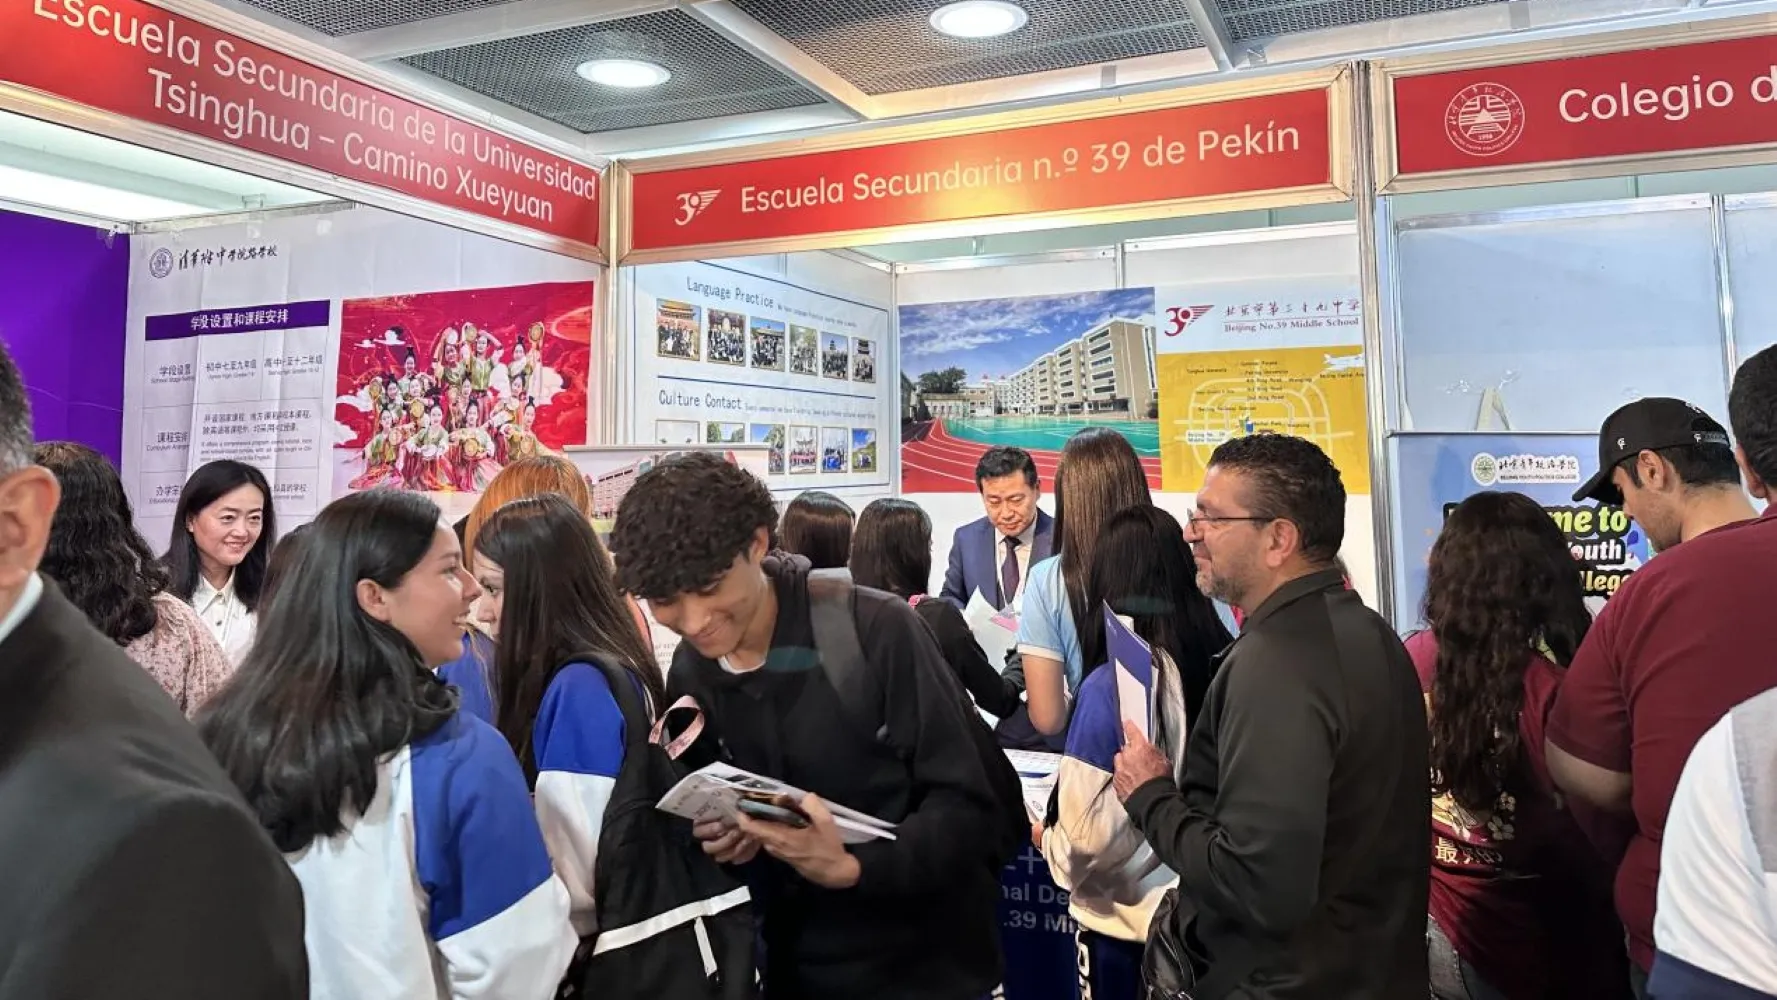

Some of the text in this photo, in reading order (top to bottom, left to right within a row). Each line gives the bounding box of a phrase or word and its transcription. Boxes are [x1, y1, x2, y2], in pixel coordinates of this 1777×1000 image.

[1558, 74, 1734, 122] Colegio
[213, 39, 395, 132] Secundaria
[404, 110, 436, 145] de
[444, 119, 466, 155] la
[473, 131, 597, 201] Universidad
[148, 68, 310, 150] Tsinghua
[343, 132, 447, 191] Camino
[455, 166, 553, 223] Xueyuan
[740, 177, 844, 214] Escuela
[852, 155, 1022, 201] Secundaria
[1091, 140, 1131, 174] 39
[1143, 135, 1186, 168] de
[1199, 120, 1300, 161] Pekín
[686, 276, 774, 309] Language Practice
[1224, 318, 1360, 333] Beijing No.39 Middle School
[658, 389, 701, 407] Culture
[705, 392, 742, 410] Contact
[156, 485, 182, 497] 办学宗
[1599, 506, 1628, 533] to
[1567, 539, 1622, 560] outh
[1579, 570, 1631, 596] leg
